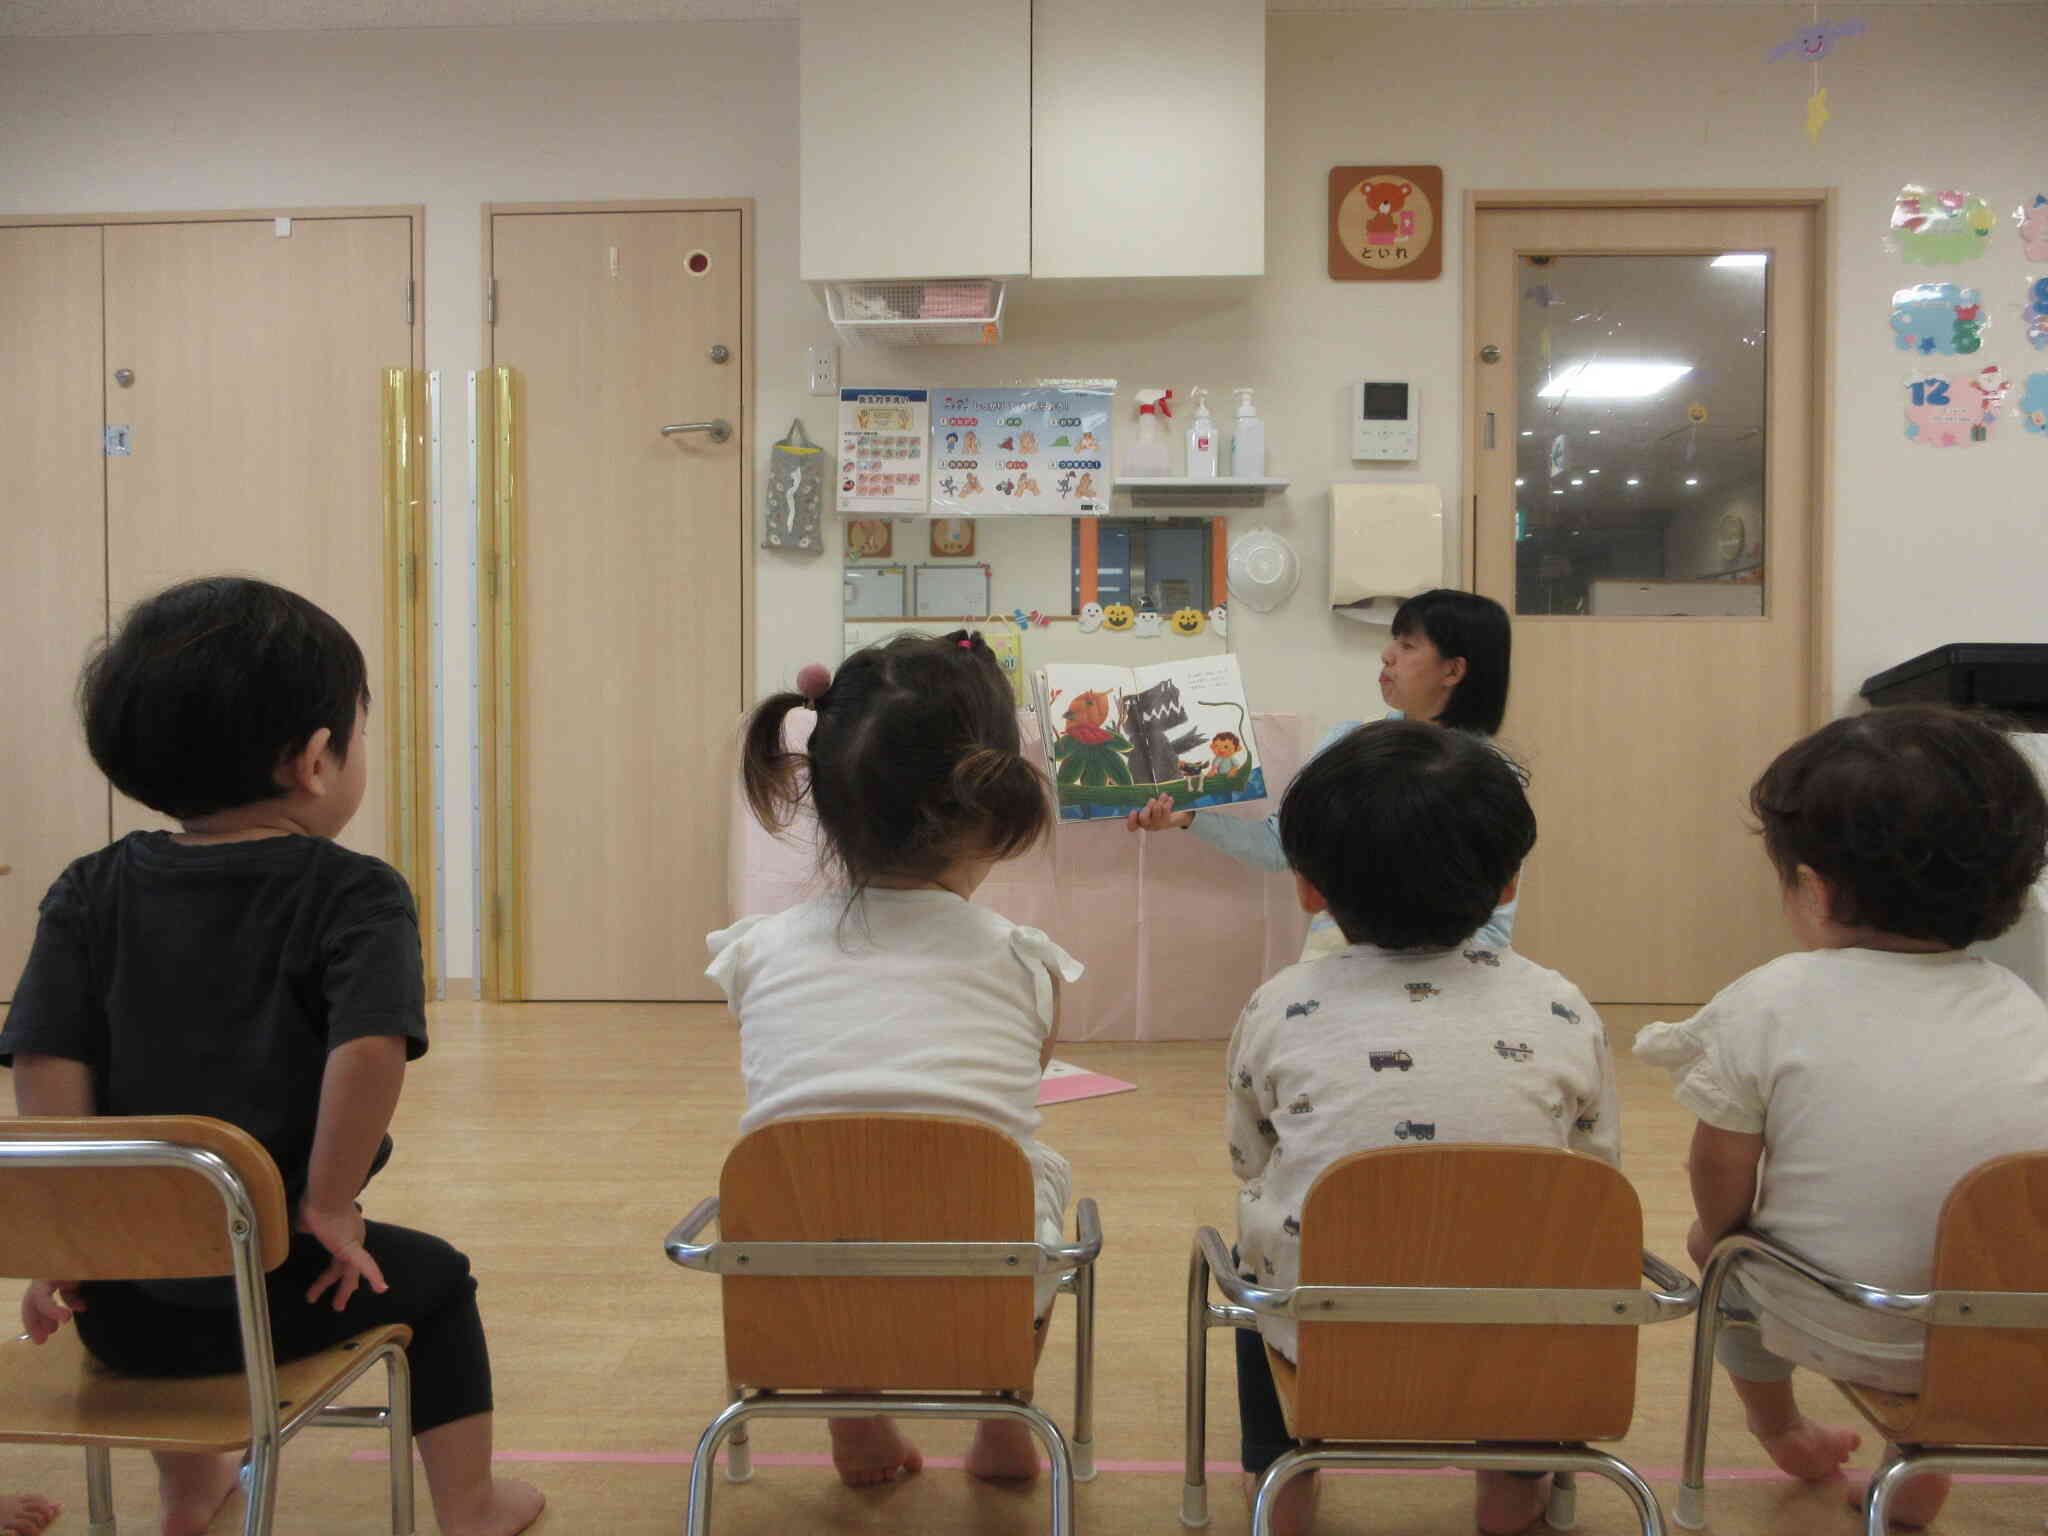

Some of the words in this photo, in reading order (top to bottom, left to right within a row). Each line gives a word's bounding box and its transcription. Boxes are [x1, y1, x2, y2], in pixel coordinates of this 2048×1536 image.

[1361, 247, 1408, 259] といれ
[1909, 378, 1950, 406] 12
